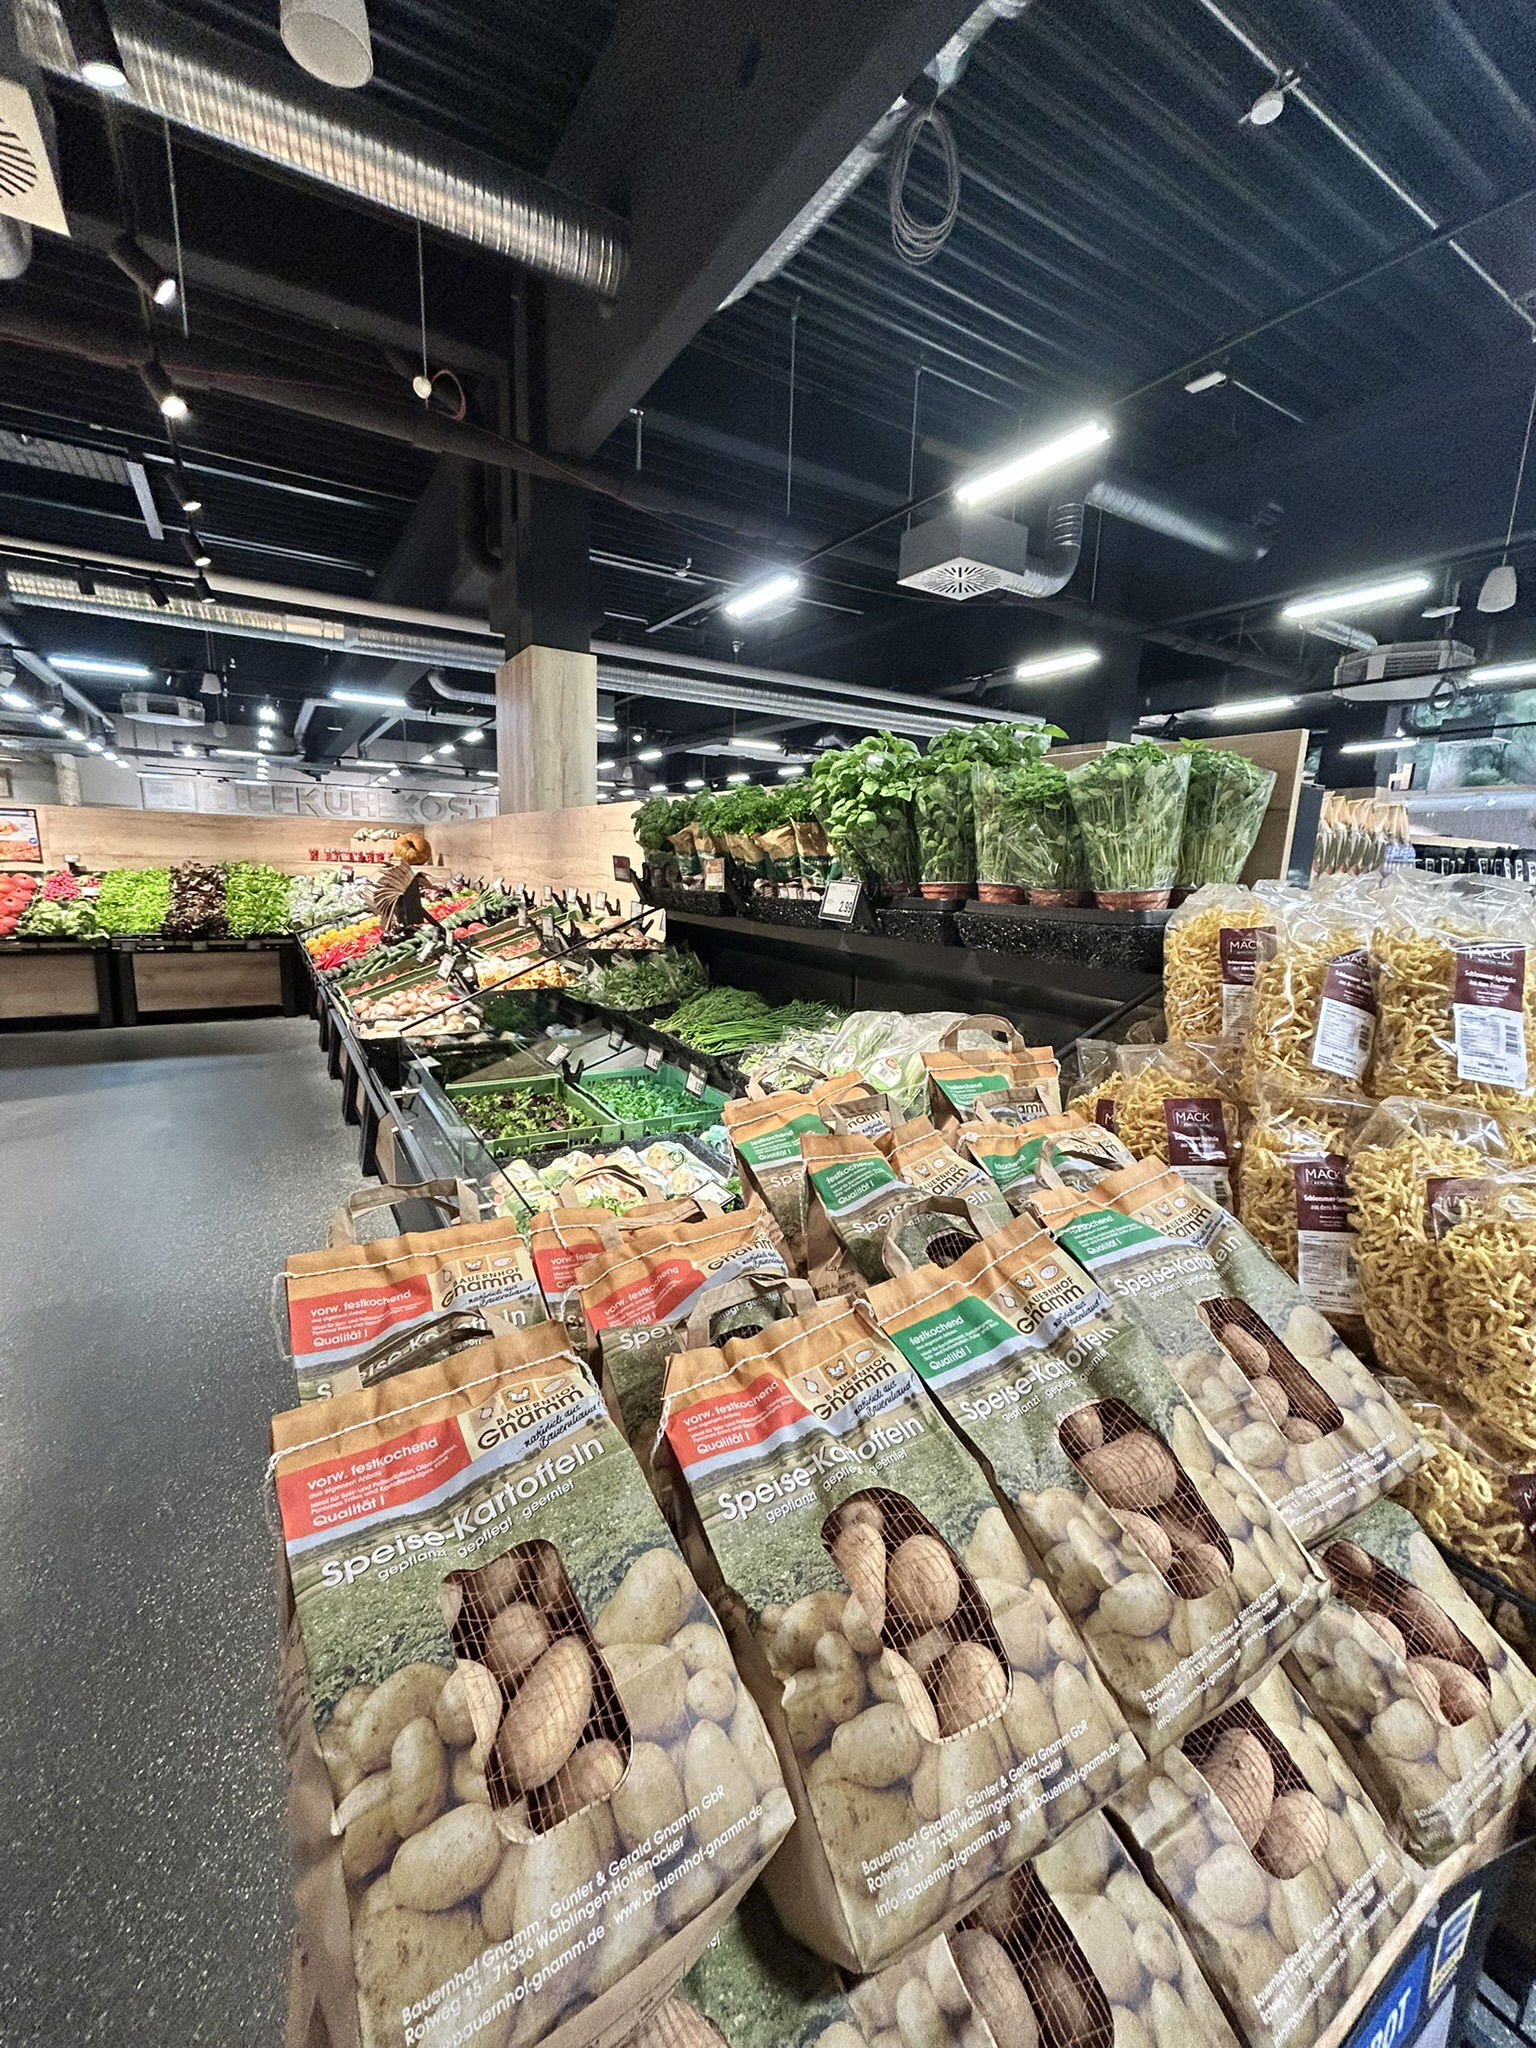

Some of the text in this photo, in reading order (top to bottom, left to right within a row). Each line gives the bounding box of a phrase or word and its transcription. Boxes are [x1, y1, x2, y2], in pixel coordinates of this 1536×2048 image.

[1229, 940, 1265, 953] MACK
[1176, 1111, 1211, 1125] MACK
[826, 1160, 875, 1184] festkochend
[932, 1167, 968, 1195] amm
[1305, 1168, 1342, 1182] MACK
[838, 1183, 870, 1205] Qualität
[1160, 1204, 1202, 1233] BAUERNHOF
[1086, 1240, 1118, 1255] Qualität
[441, 1270, 524, 1308] Gnamm
[452, 1266, 520, 1286] BAUERNHOF
[1023, 1275, 1074, 1315] BAUERNHOF
[310, 1304, 342, 1317] vorw.
[344, 1288, 412, 1311] festkochend
[604, 1297, 628, 1316] vorw.
[1016, 1284, 1085, 1335] Gnamm
[313, 1331, 362, 1347] Qualität
[909, 1314, 965, 1346] festkochend
[929, 1346, 967, 1370] Qualität
[813, 1361, 898, 1420] Gnamm
[824, 1355, 887, 1402] BAUERNHOF
[1002, 1395, 1041, 1423] gepflanzt
[1080, 1348, 1110, 1383] geerntet
[477, 1388, 584, 1451] Gnamm
[496, 1383, 576, 1426] BAUERNHOF
[563, 1403, 581, 1418] aus
[683, 1409, 714, 1426] vorw.
[715, 1380, 779, 1415] festkochend
[697, 1431, 751, 1455] Qualität I
[306, 1436, 439, 1490] vorw. festkochend
[308, 1490, 323, 1500] aus
[324, 1478, 358, 1495] eigenem
[765, 1447, 909, 1524] gepflanzt geerntet
[312, 1494, 386, 1527] Qualität I
[320, 1437, 607, 1588] Speise-Kartoffeln
[375, 1477, 576, 1584] gepflanzt gepflegt geerntet
[1139, 1668, 1179, 1703] Bauernhof
[1178, 1646, 1208, 1672] Gnamm
[861, 1719, 1088, 1876] Bauernhof Gnamm Günter & Gerald Gnamm GbR
[866, 1757, 1064, 1893] Rotweg 15 71336 Waiblingen-Hohenacker
[613, 1804, 764, 1927] www.bauernhof-gnamm.de
[400, 1785, 727, 2027] Bauernhof Gnamm Günter & Gerald Gnamm GbR
[404, 1996, 463, 2048] Rotweg
[464, 1984, 482, 2003] 15
[493, 1946, 535, 1983] 71336
[535, 1834, 686, 1951] Waiblingen-Hohenacker
